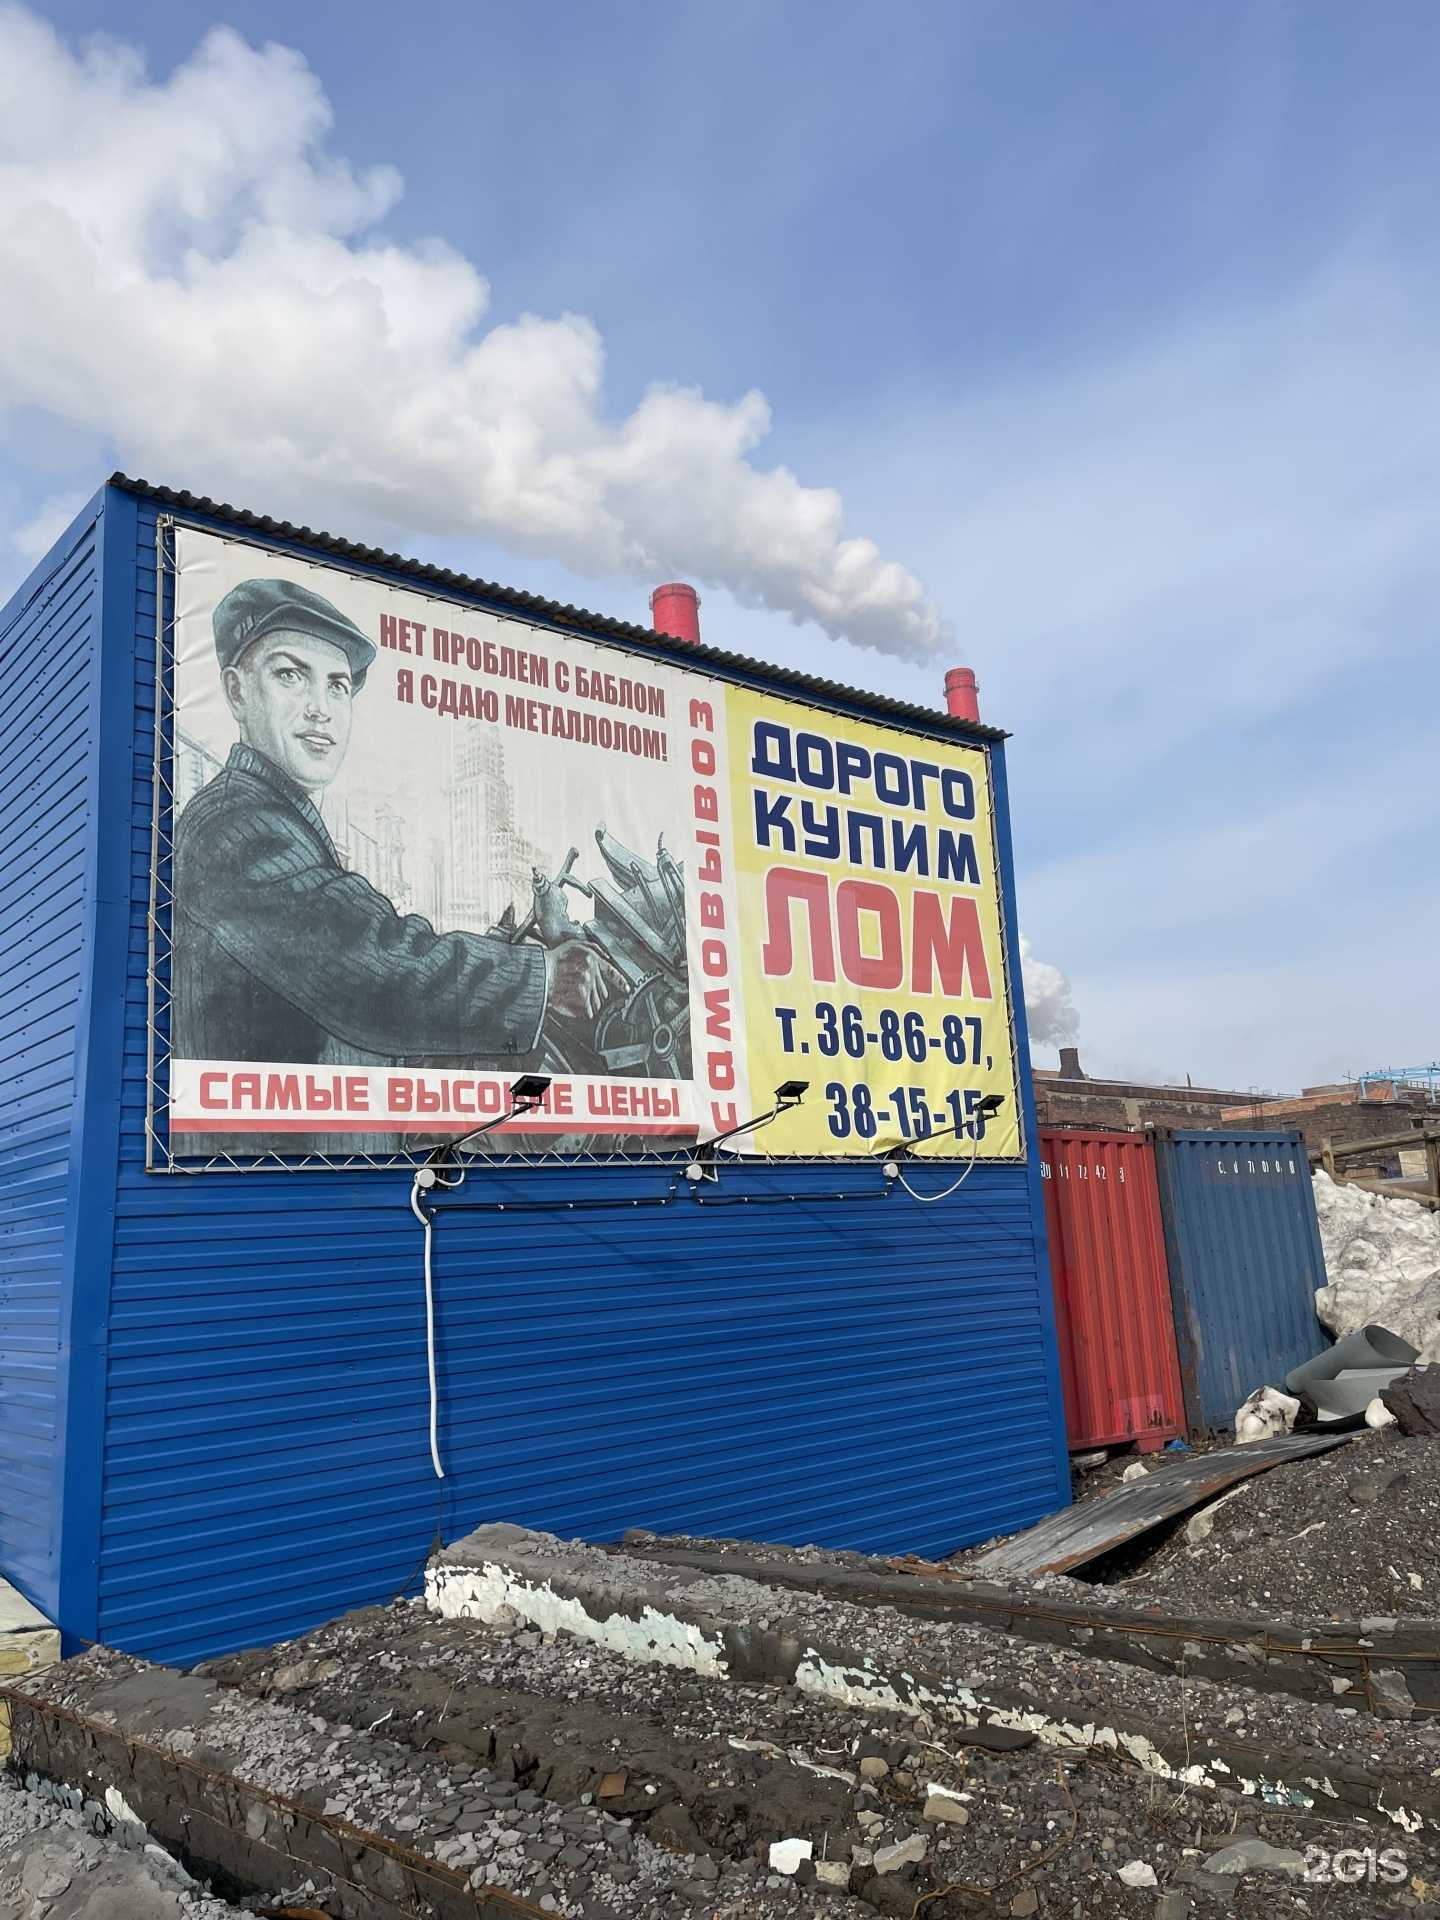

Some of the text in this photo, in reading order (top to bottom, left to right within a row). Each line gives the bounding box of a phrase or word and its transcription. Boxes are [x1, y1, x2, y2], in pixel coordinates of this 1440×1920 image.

[380, 613, 666, 718] НЕТ ПРОБЛЕМ С БАБЛОМ
[397, 669, 668, 762] Я СДАЮ МЕТАЛЛОЛОМ!
[752, 720, 976, 820] ДОРОГО
[754, 789, 981, 885] КУПИМ
[763, 867, 993, 999] ЛОМ
[199, 1071, 370, 1112] САМЫЕ
[587, 1084, 681, 1118] ЦЕНЫ
[825, 1082, 986, 1140] 38-15-15
